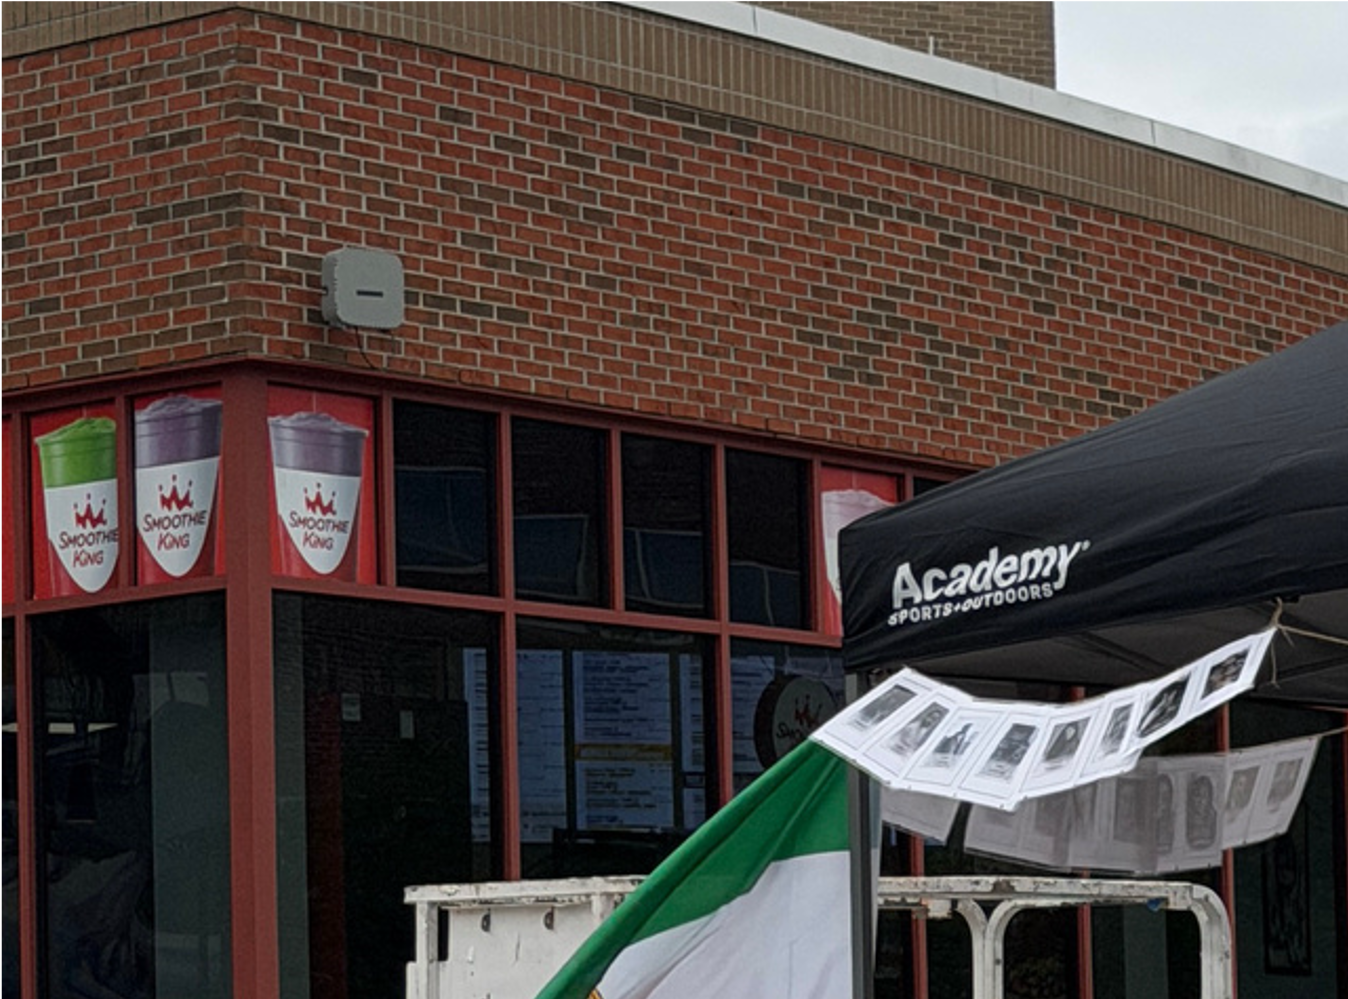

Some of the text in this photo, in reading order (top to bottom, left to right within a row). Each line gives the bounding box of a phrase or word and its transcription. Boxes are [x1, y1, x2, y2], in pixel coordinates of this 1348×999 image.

[143, 510, 207, 532] SMOOTHIE
[289, 509, 349, 534] SMOOTHIE
[59, 528, 119, 549] SMOOTHIE
[157, 532, 190, 550] KING
[302, 531, 333, 550] KING
[73, 550, 103, 568] KING
[892, 541, 1082, 609] Academy
